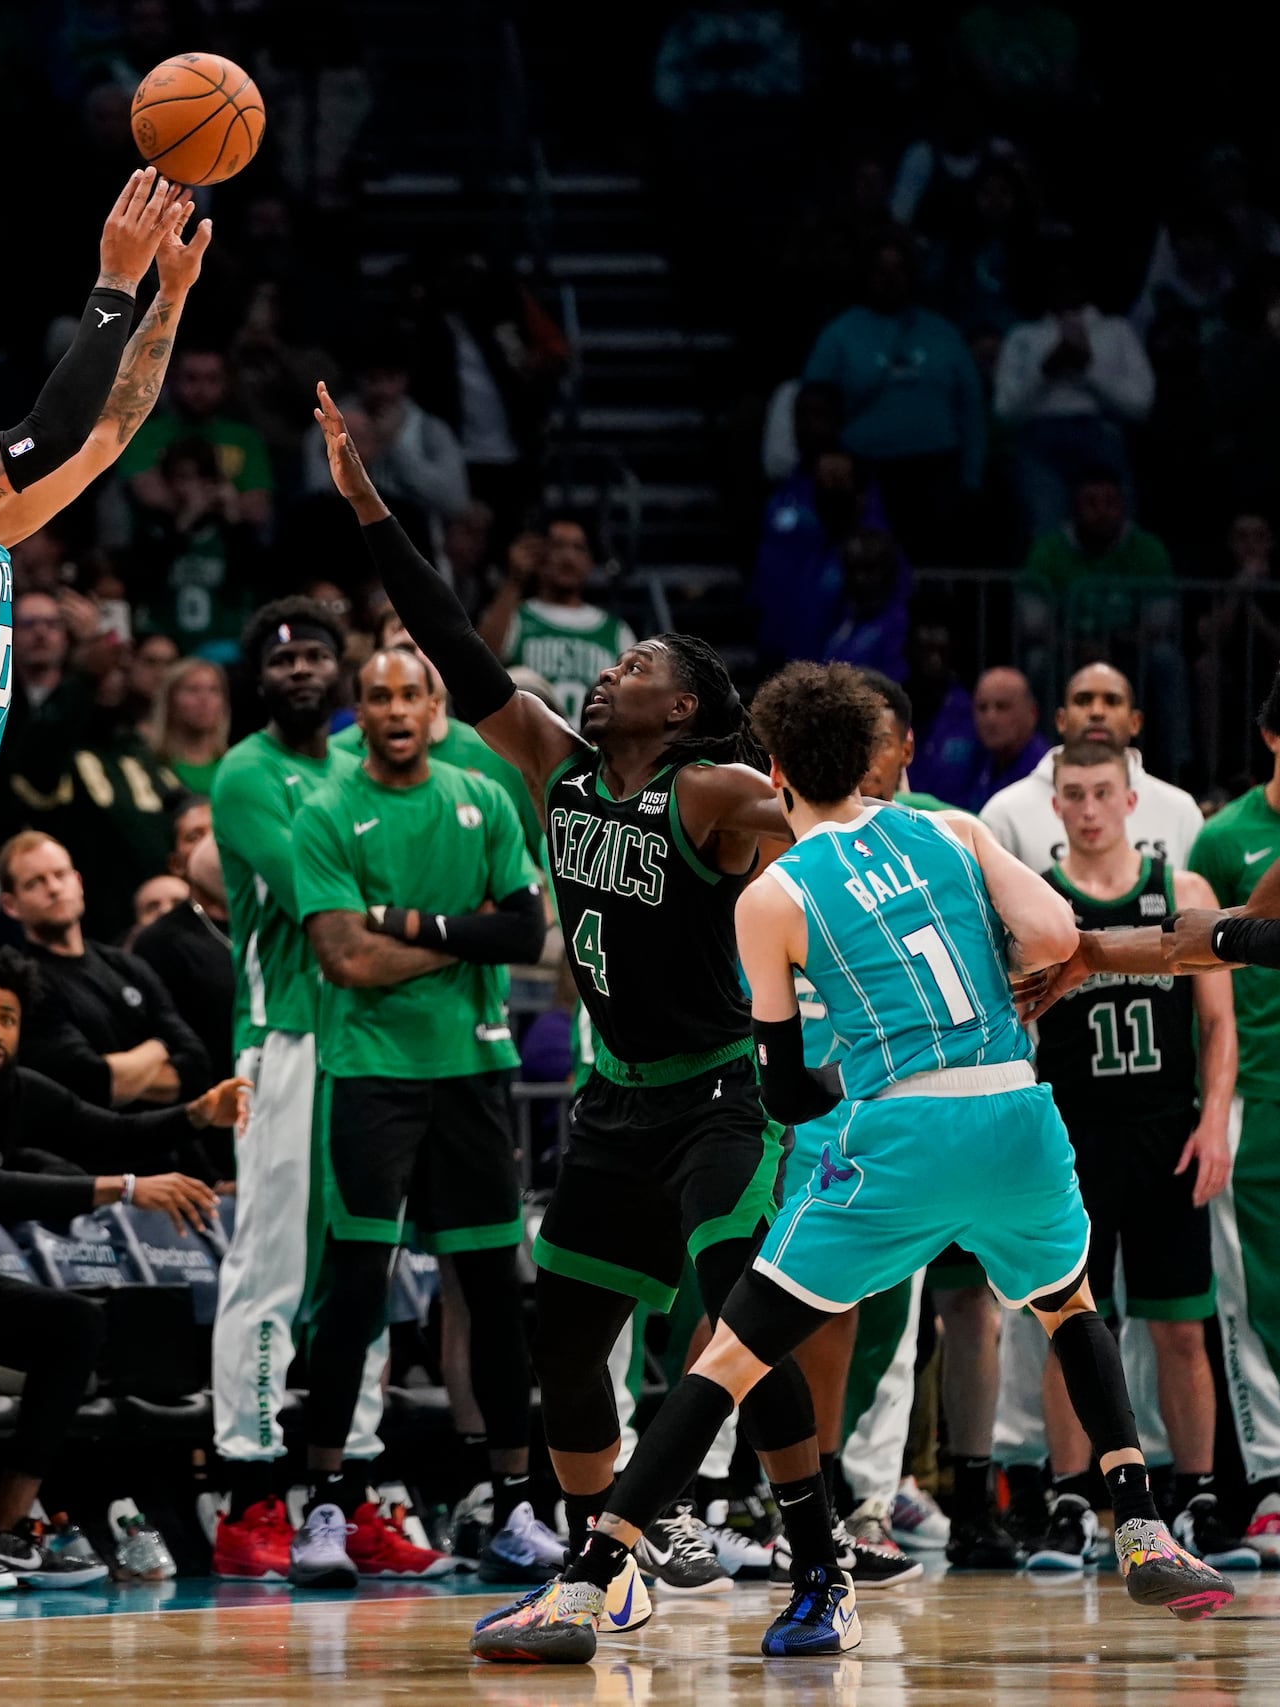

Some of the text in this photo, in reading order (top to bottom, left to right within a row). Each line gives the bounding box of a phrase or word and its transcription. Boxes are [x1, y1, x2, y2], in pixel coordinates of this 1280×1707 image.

[637, 802, 666, 815] PRINT
[844, 855, 928, 913] BALL
[572, 909, 610, 997] 4
[900, 922, 977, 1027] 1
[1088, 999, 1161, 1077] 11
[258, 1320, 274, 1386] BOSTON
